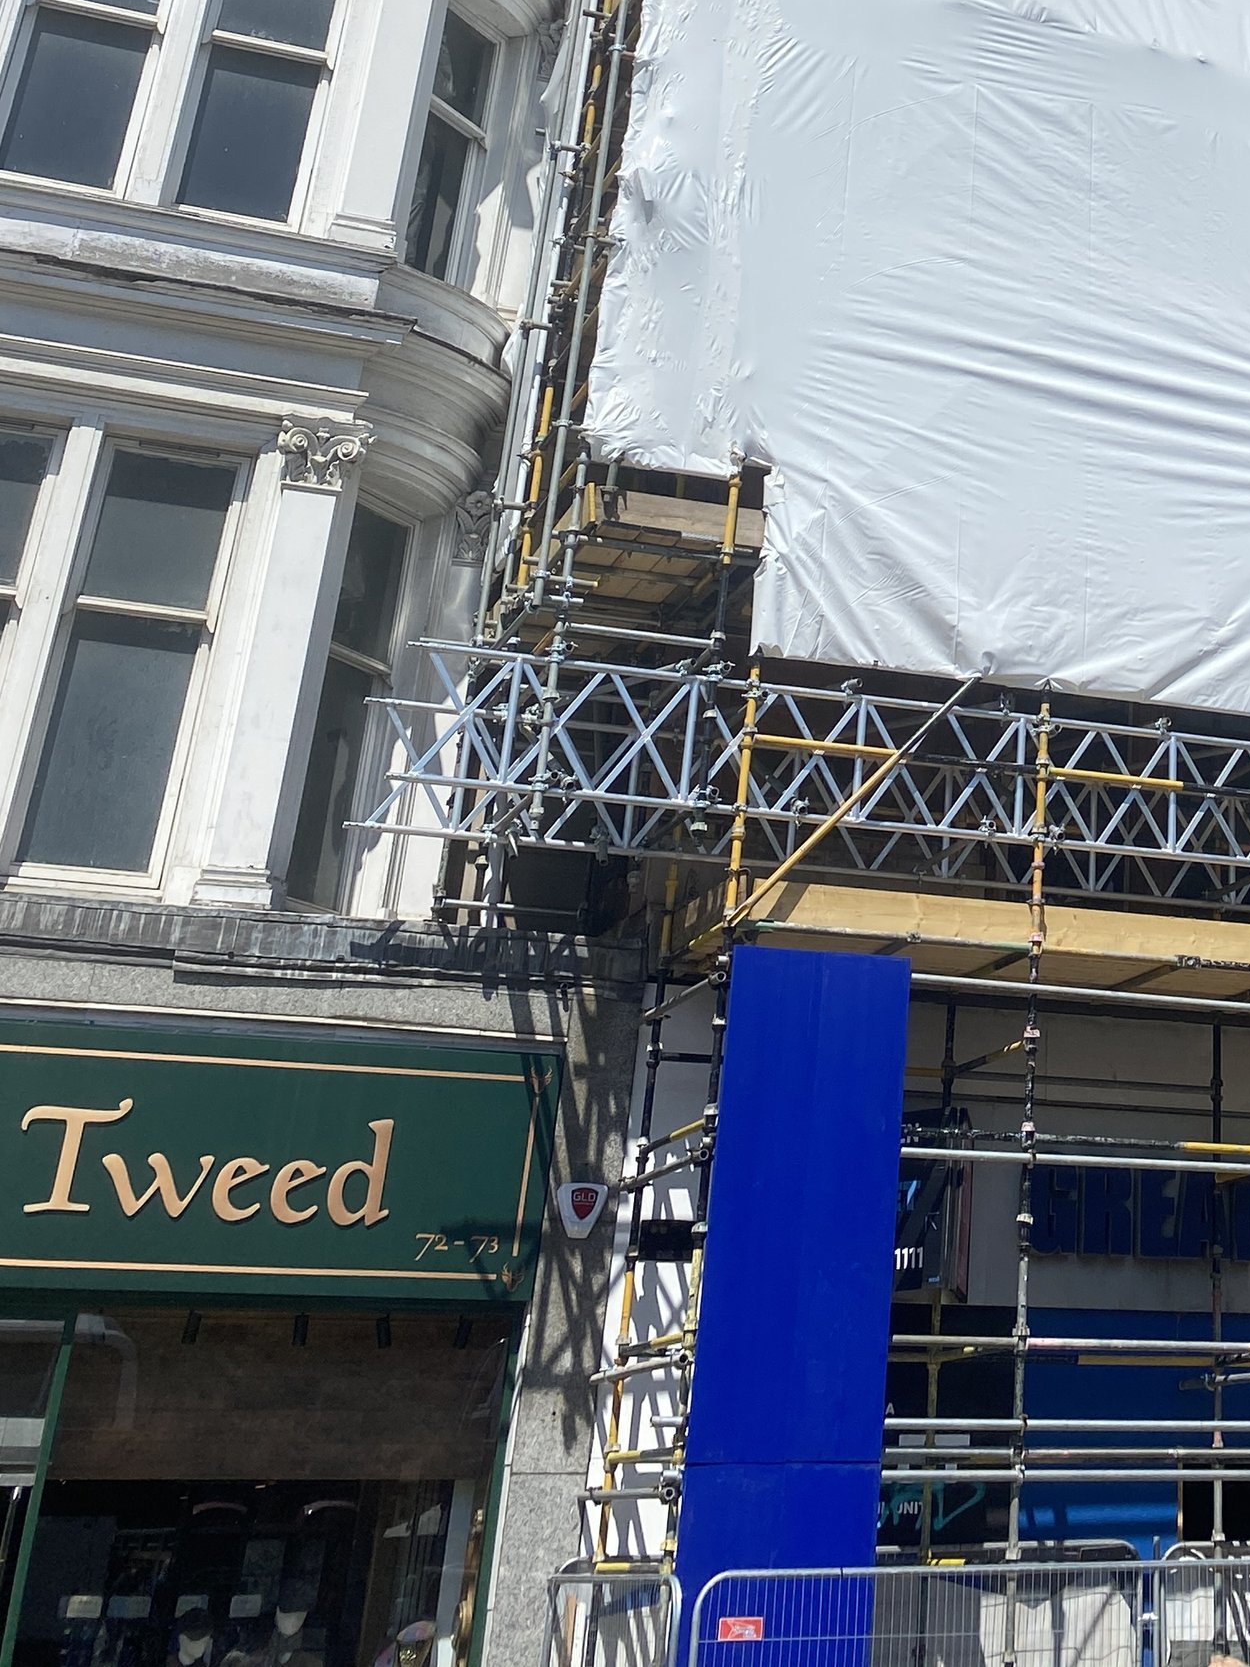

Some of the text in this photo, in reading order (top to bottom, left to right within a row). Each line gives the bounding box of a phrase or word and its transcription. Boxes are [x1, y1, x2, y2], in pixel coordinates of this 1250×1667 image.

[20, 1097, 395, 1227] Tweed
[573, 1191, 597, 1202] GLD
[414, 1233, 448, 1262] 72
[469, 1235, 499, 1264] 73
